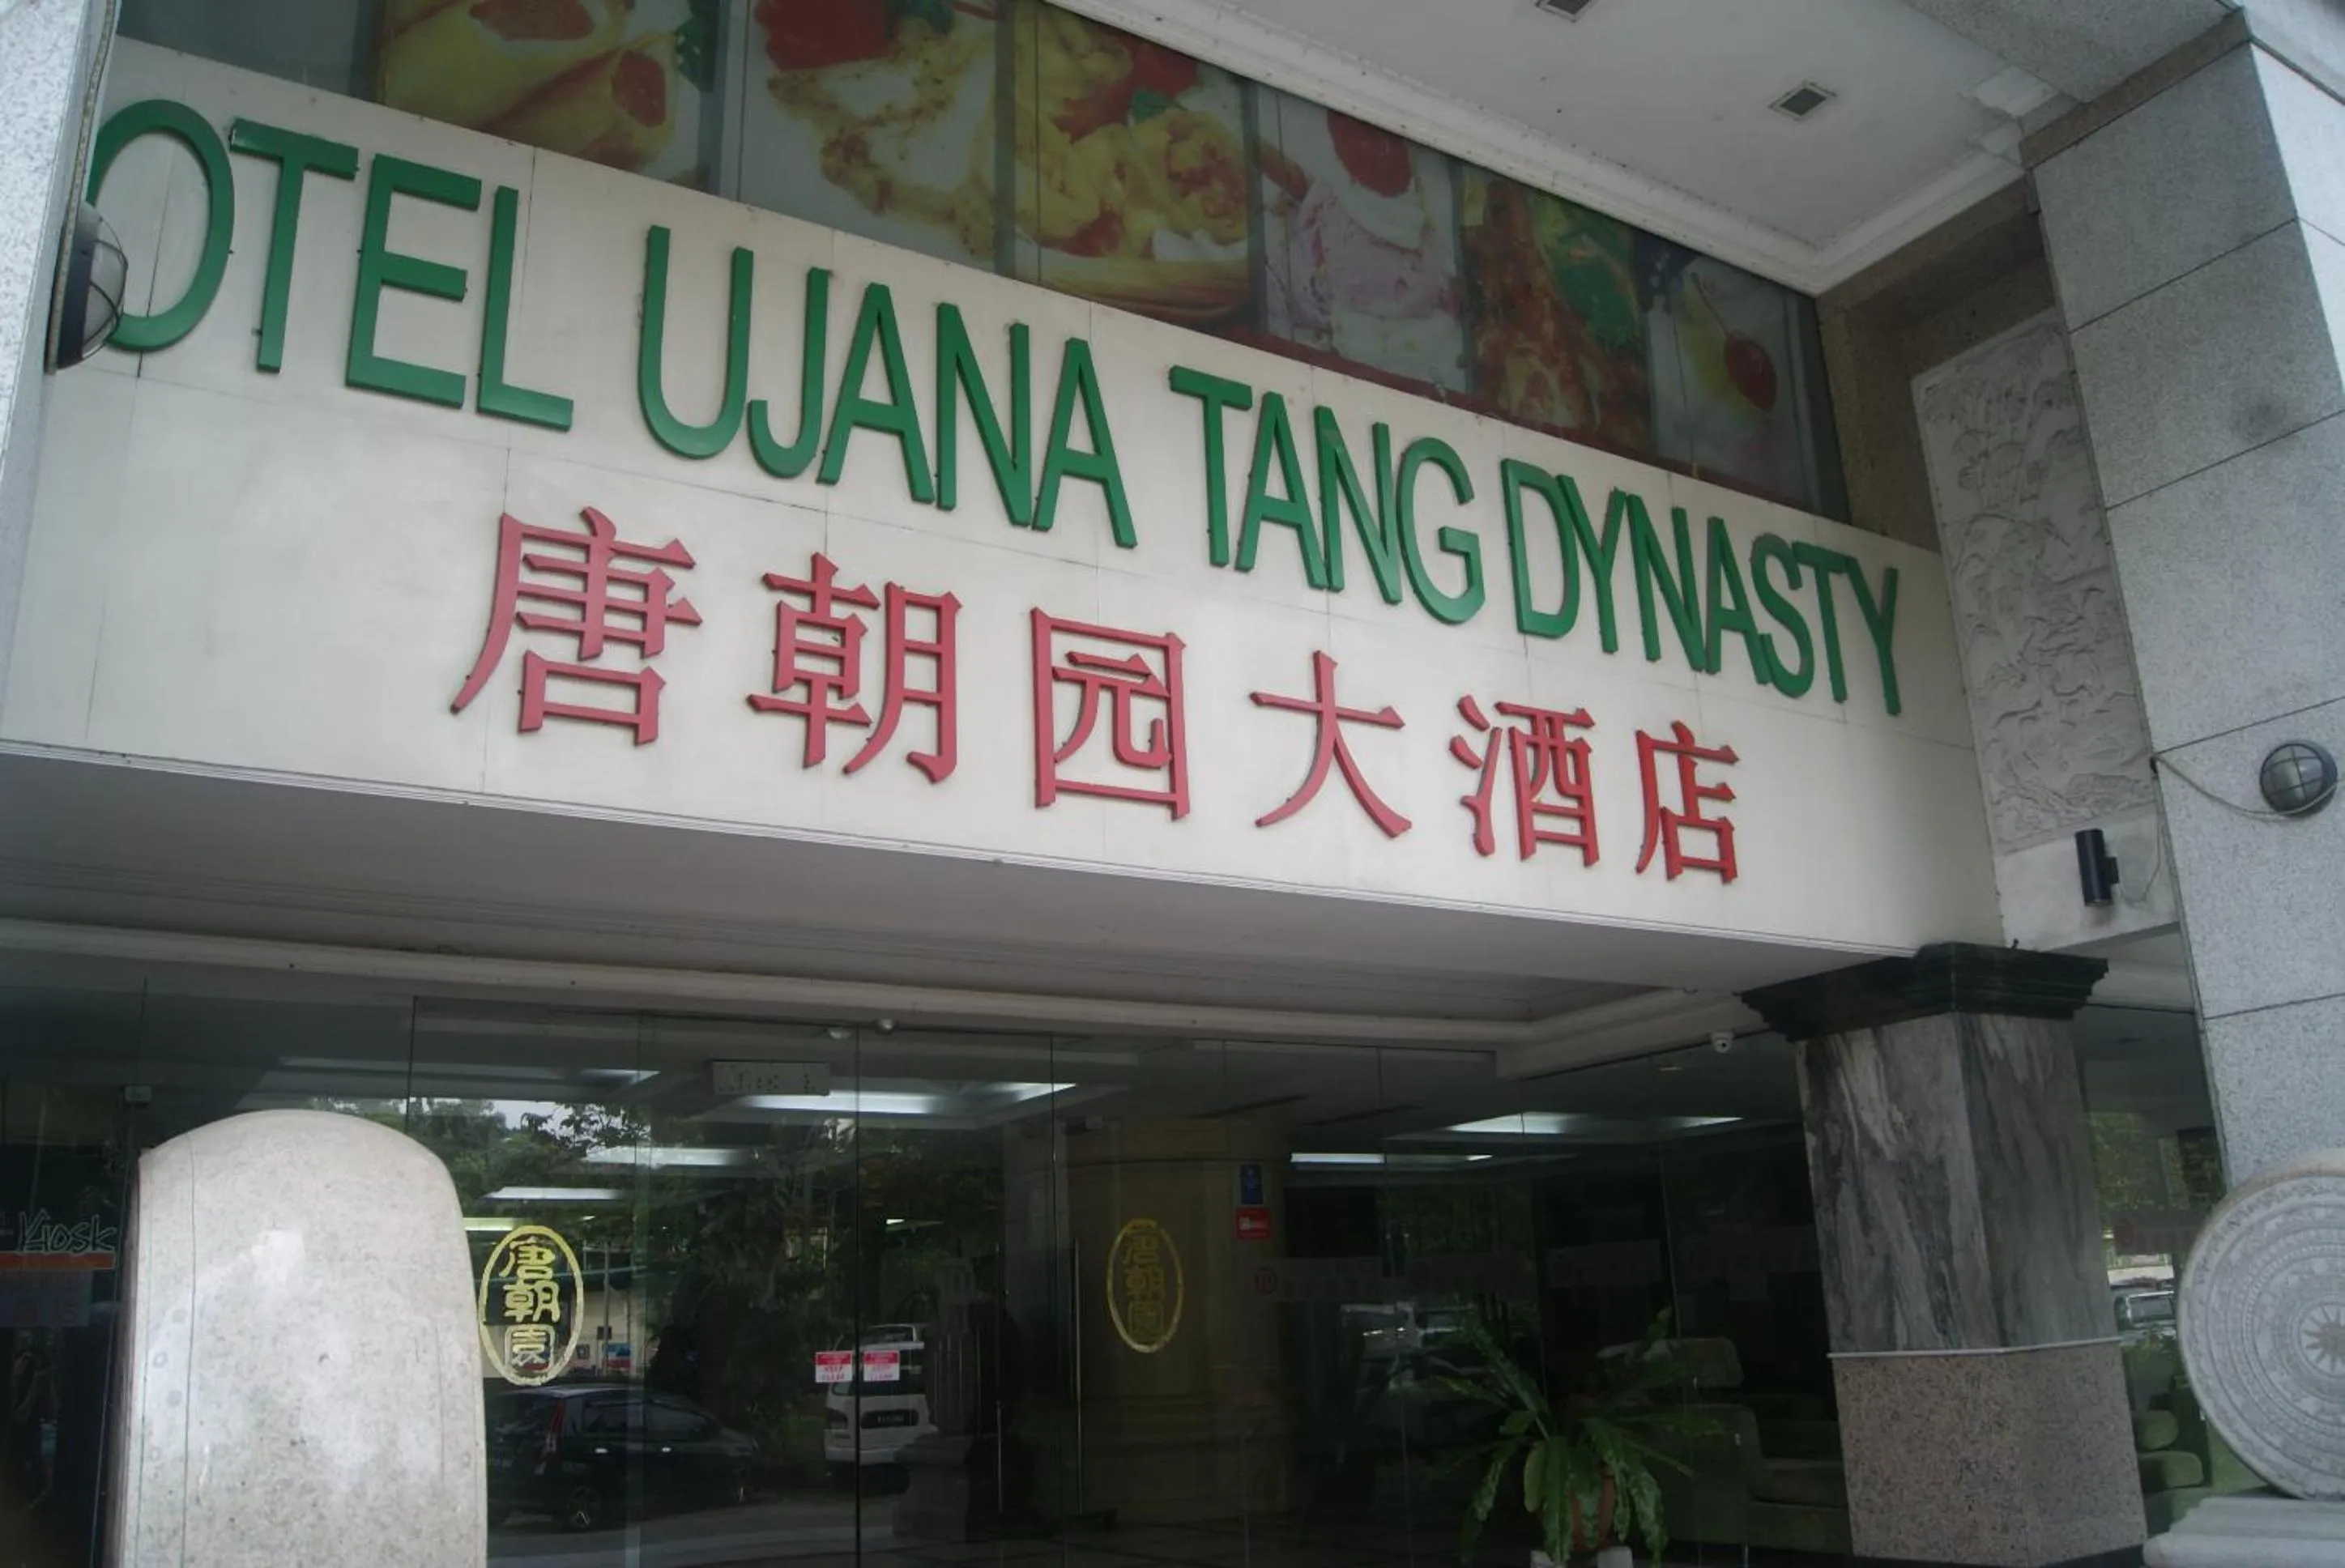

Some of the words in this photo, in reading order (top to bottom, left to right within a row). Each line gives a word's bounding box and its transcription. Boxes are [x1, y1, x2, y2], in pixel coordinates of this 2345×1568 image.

[637, 225, 1138, 549] UJANA
[1169, 364, 1486, 625] TANG
[1500, 458, 1902, 717] DYNASTY
[450, 506, 1741, 884] 唐朝园大酒店
[17, 1208, 118, 1256] Kiosk
